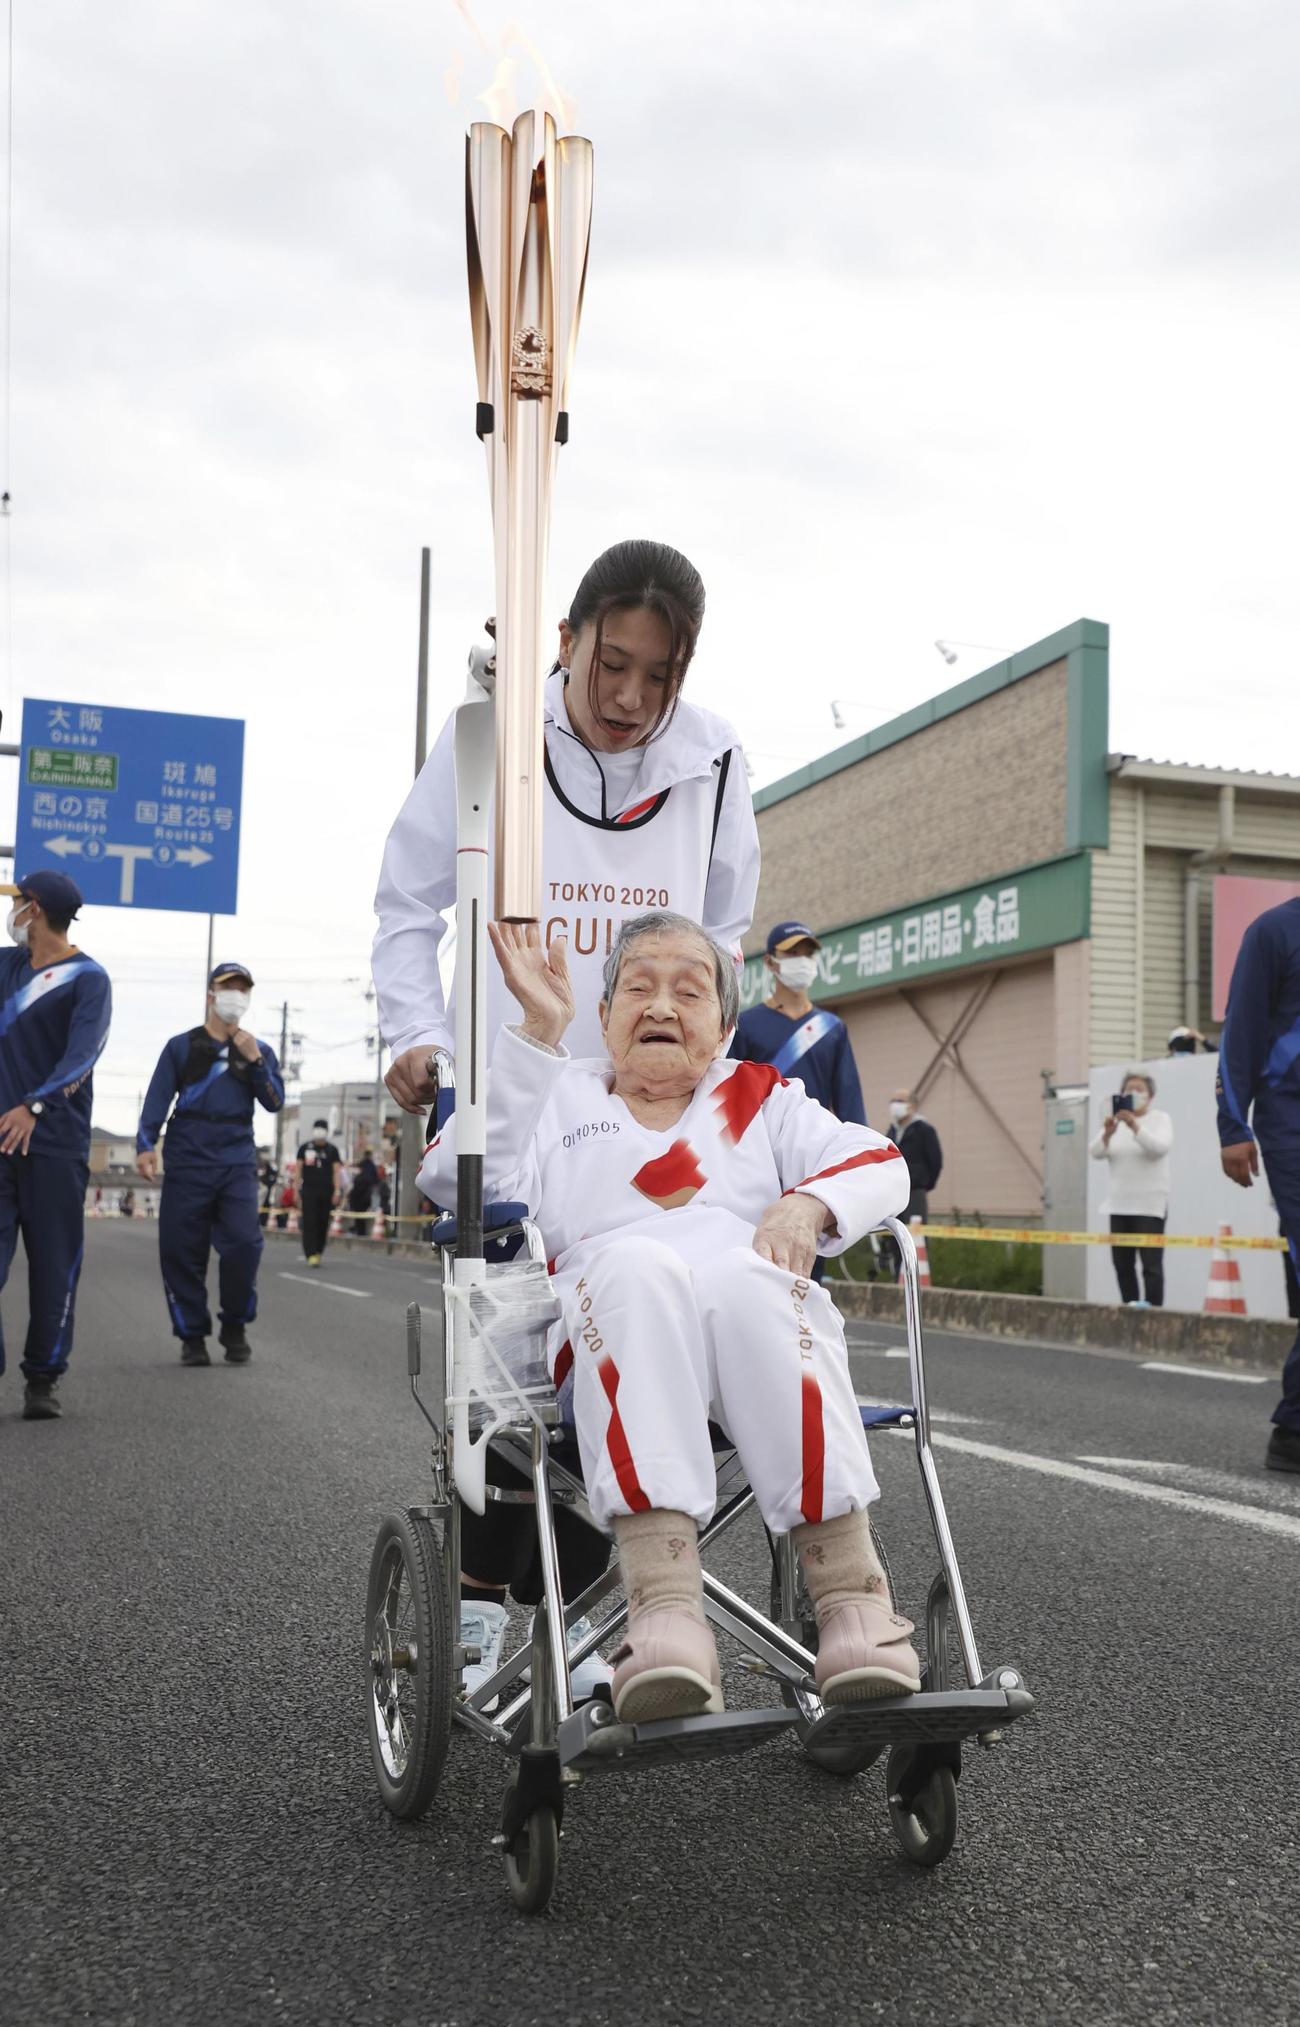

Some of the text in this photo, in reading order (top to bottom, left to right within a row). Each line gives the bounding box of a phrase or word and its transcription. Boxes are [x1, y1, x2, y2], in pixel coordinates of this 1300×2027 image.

[47, 706, 104, 733] 大阪
[51, 729, 98, 747] Osaka
[33, 792, 107, 819] 西の京
[135, 800, 233, 831] 国道25号
[549, 883, 669, 907] TOKYO 2020
[545, 916, 626, 955] GUI
